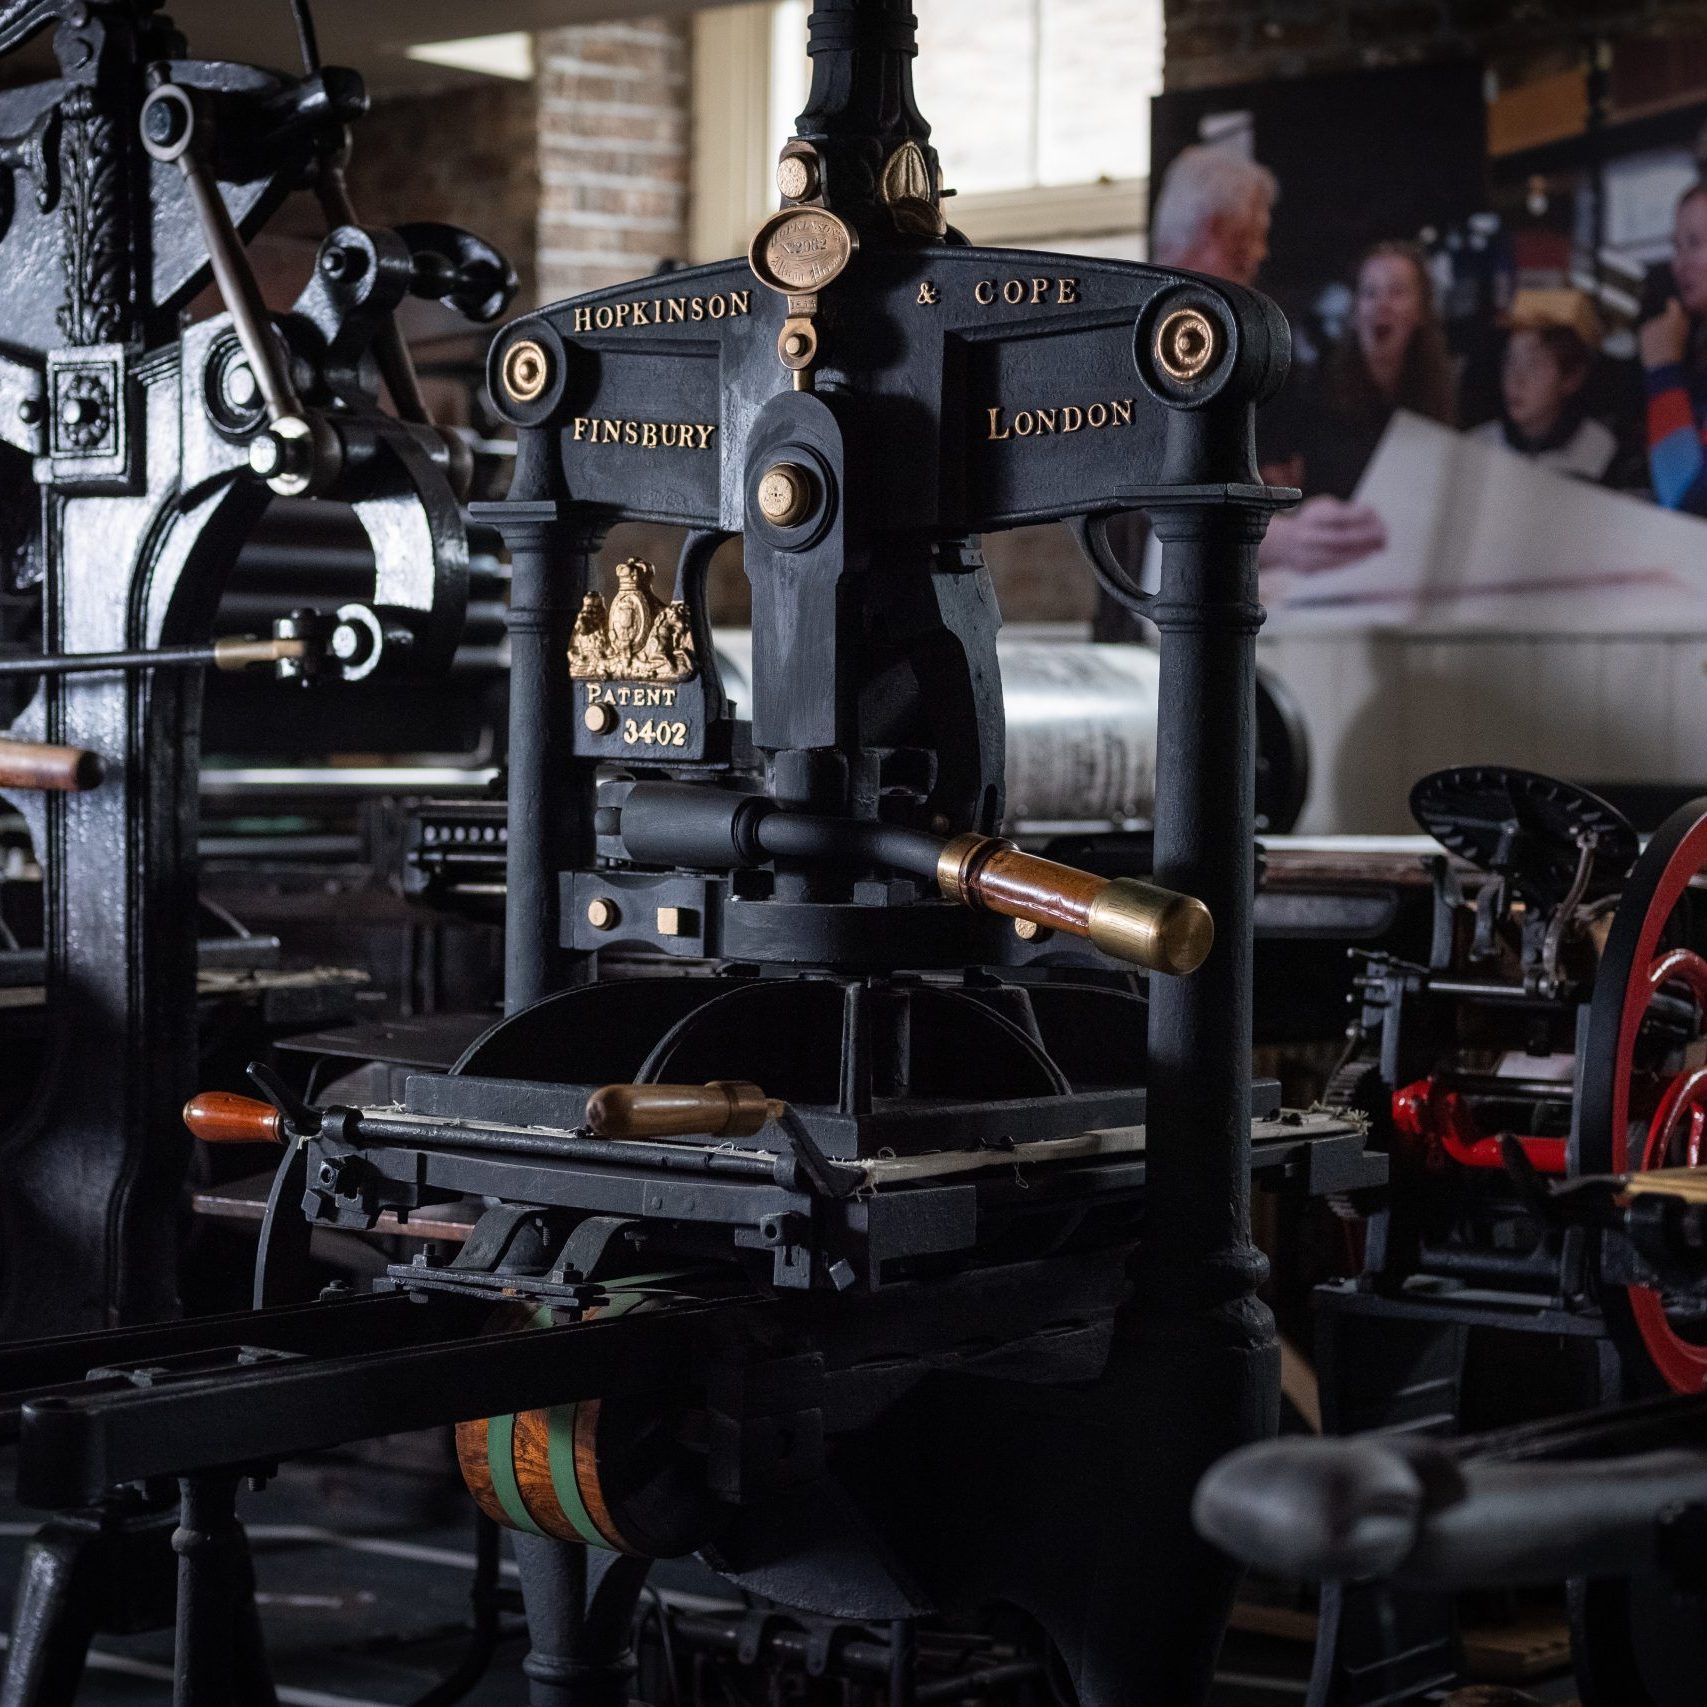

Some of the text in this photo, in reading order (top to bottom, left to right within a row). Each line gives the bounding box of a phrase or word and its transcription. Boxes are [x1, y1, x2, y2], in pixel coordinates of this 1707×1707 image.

[574, 278, 1079, 332] HOPKINSON & COPE
[573, 399, 1135, 449] FINSBURY LONDON
[586, 683, 676, 706] PATENT
[623, 718, 687, 746] 3402
